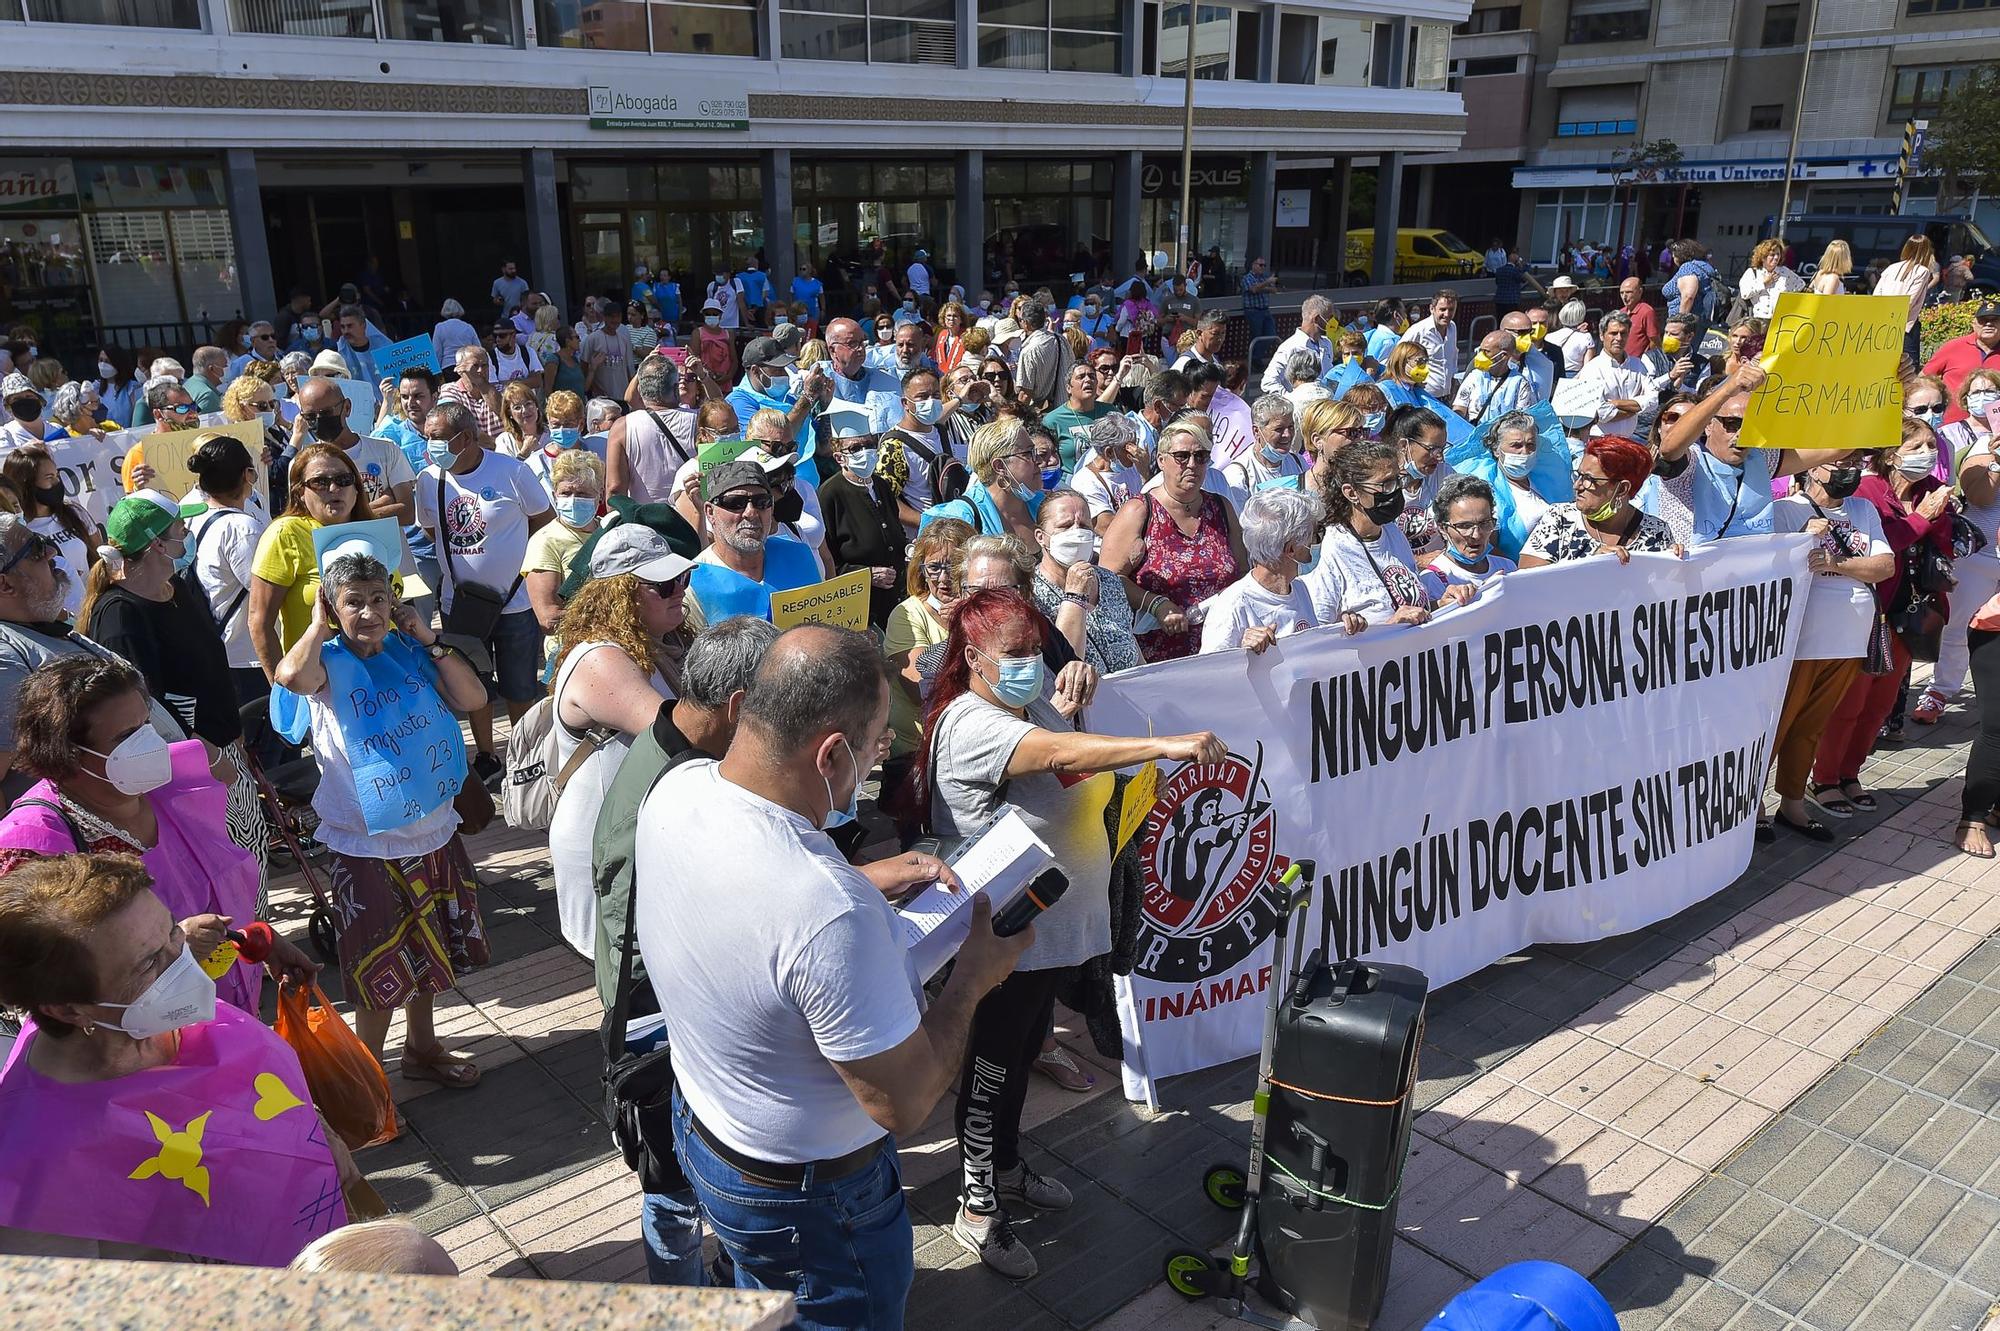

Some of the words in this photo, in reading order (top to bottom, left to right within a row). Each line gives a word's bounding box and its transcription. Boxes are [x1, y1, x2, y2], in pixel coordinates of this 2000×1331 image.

[615, 93, 677, 113] Abogada
[1663, 167, 1716, 182] Mutua
[1754, 372, 1901, 416] PERMANENTE
[722, 447, 734, 456] LA
[781, 583, 864, 615] RESPONSABLES
[1311, 641, 1476, 784] NINGUNA
[1483, 609, 1627, 730] PERSONA
[1632, 597, 1677, 695] SIN
[1684, 576, 1793, 682] ESTUDIAR
[1143, 762, 1238, 845] SOLIDARIDAD
[1214, 828, 1268, 915] POPULAR
[1320, 814, 1462, 965] NINGÚN
[1469, 785, 1628, 912] DOCENTE
[1633, 769, 1677, 869] SIN
[1138, 964, 1273, 1022] INÁMAR
